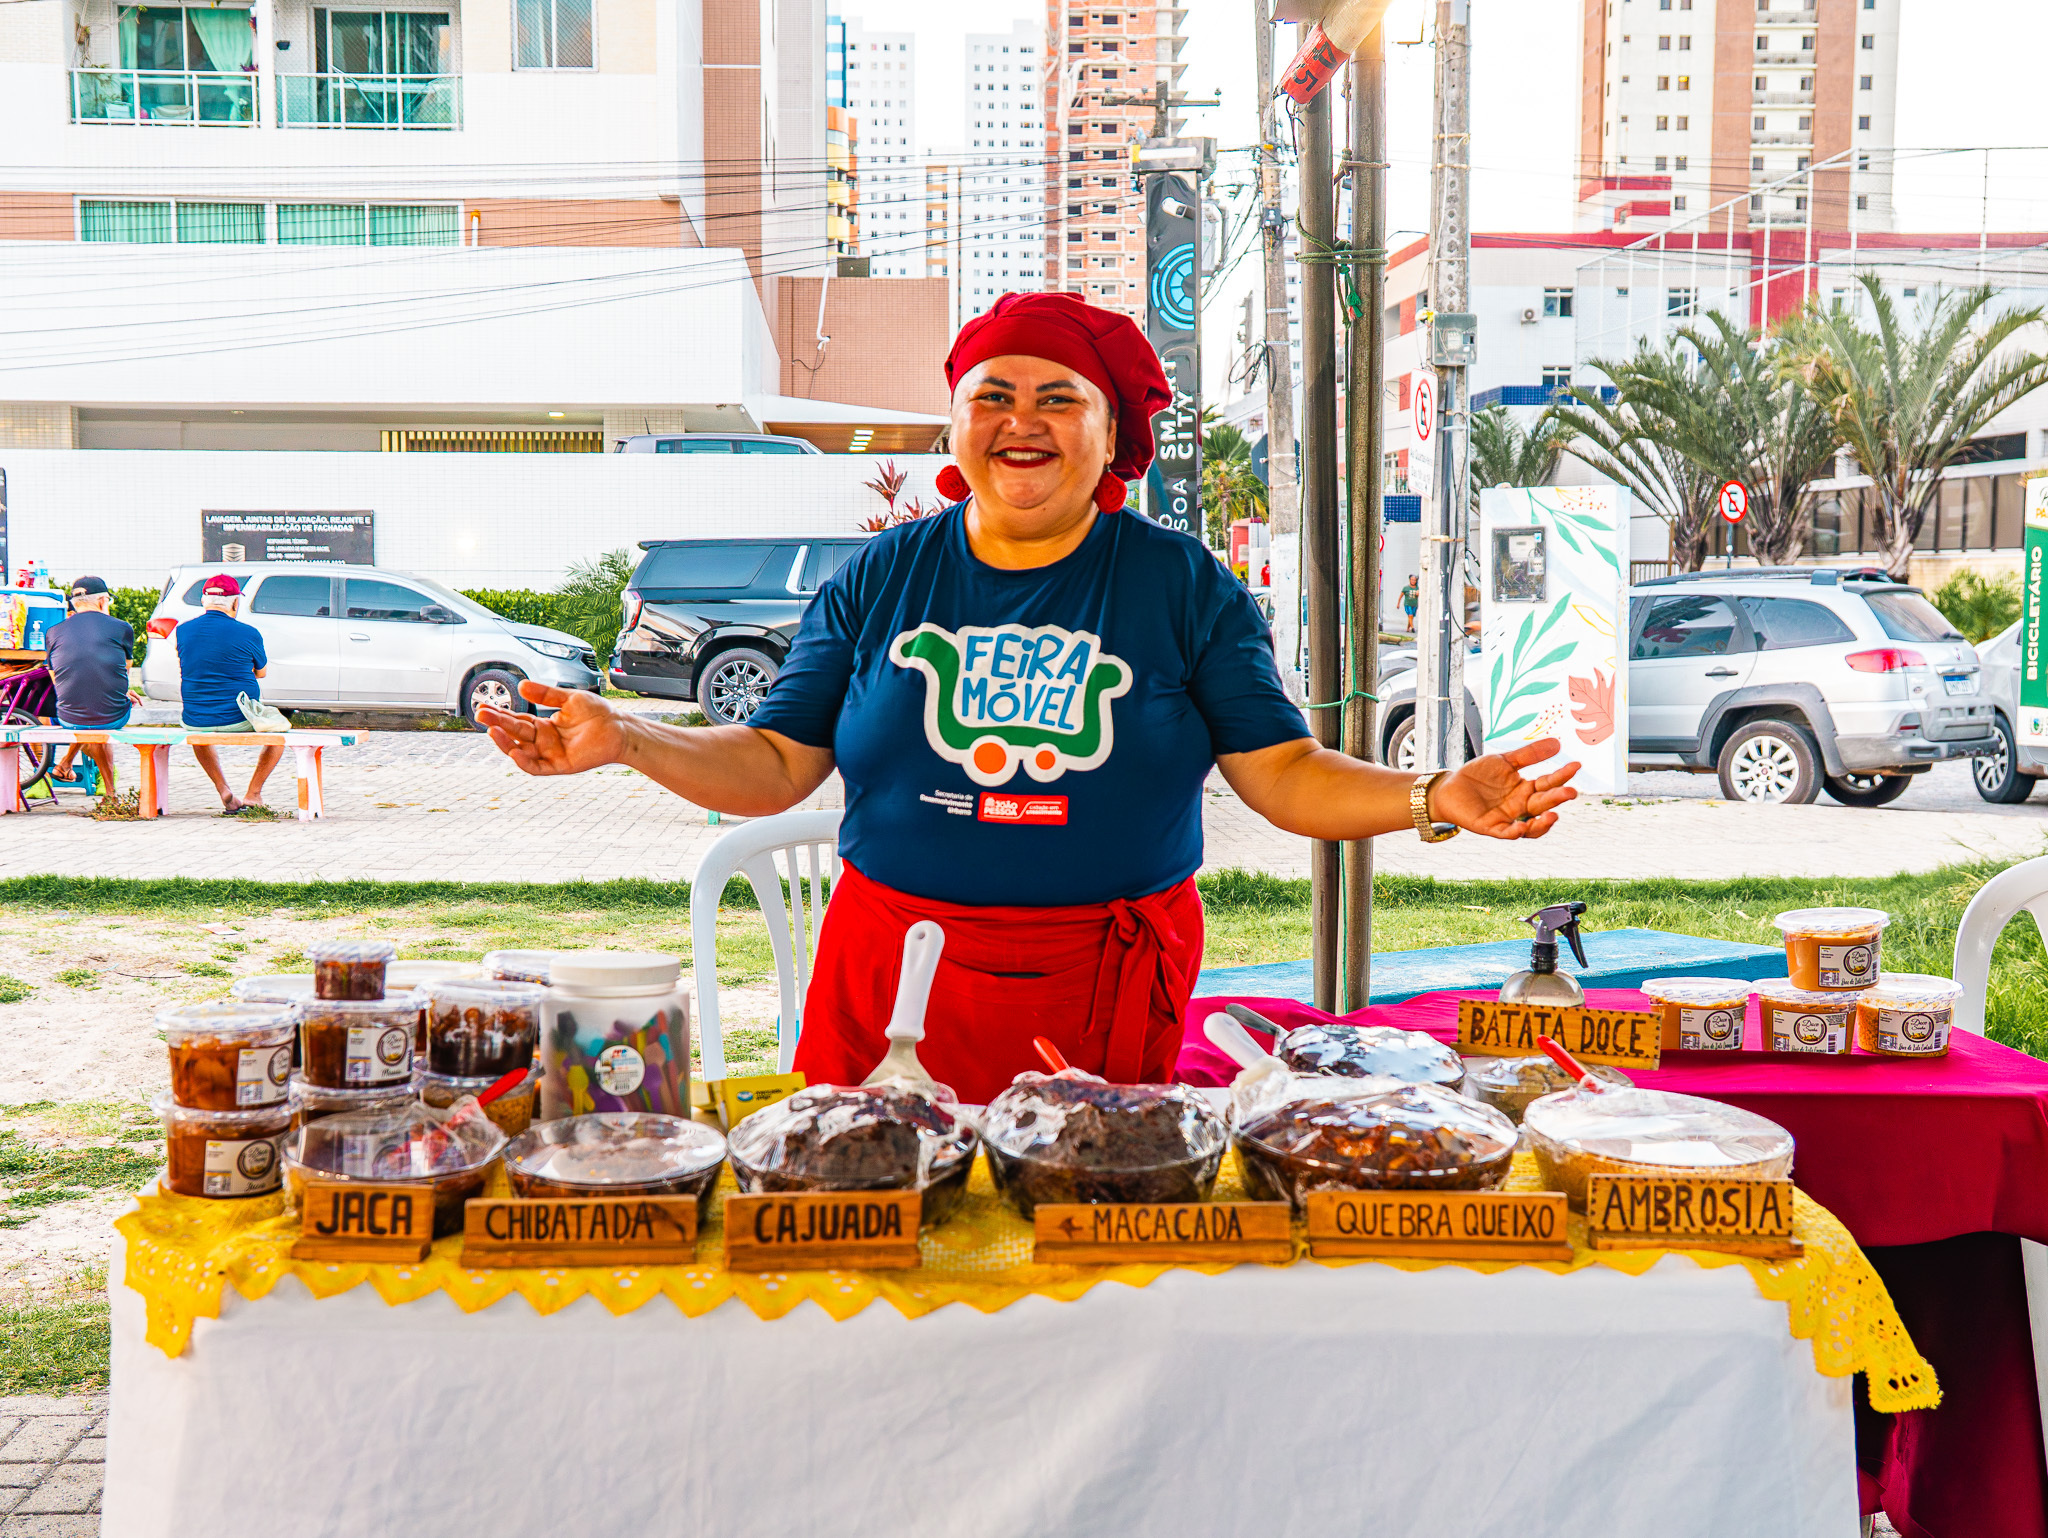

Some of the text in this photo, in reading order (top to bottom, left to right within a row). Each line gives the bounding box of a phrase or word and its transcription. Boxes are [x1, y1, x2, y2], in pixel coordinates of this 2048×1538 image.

[1176, 390, 1194, 460] CITY
[223, 523, 354, 533] IMPERMEABILIZAÇÃO DE FACHADAS
[244, 515, 273, 524] JUNTAS
[274, 515, 285, 523] DE
[330, 515, 364, 524] REJUNTE
[364, 516, 371, 524] E
[2025, 545, 2043, 681] BICICLETÁRIO
[961, 677, 1076, 730] MÓVEL
[984, 806, 1018, 816] PESSOA
[1470, 1007, 1646, 1055] BATATA DOCE
[315, 1192, 413, 1235] JACA
[485, 1202, 654, 1240] CHIBATADA
[755, 1202, 902, 1244] CAJUADA
[1092, 1206, 1244, 1243] MACACADA
[1335, 1202, 1556, 1239] QUEBRA QUEIXO
